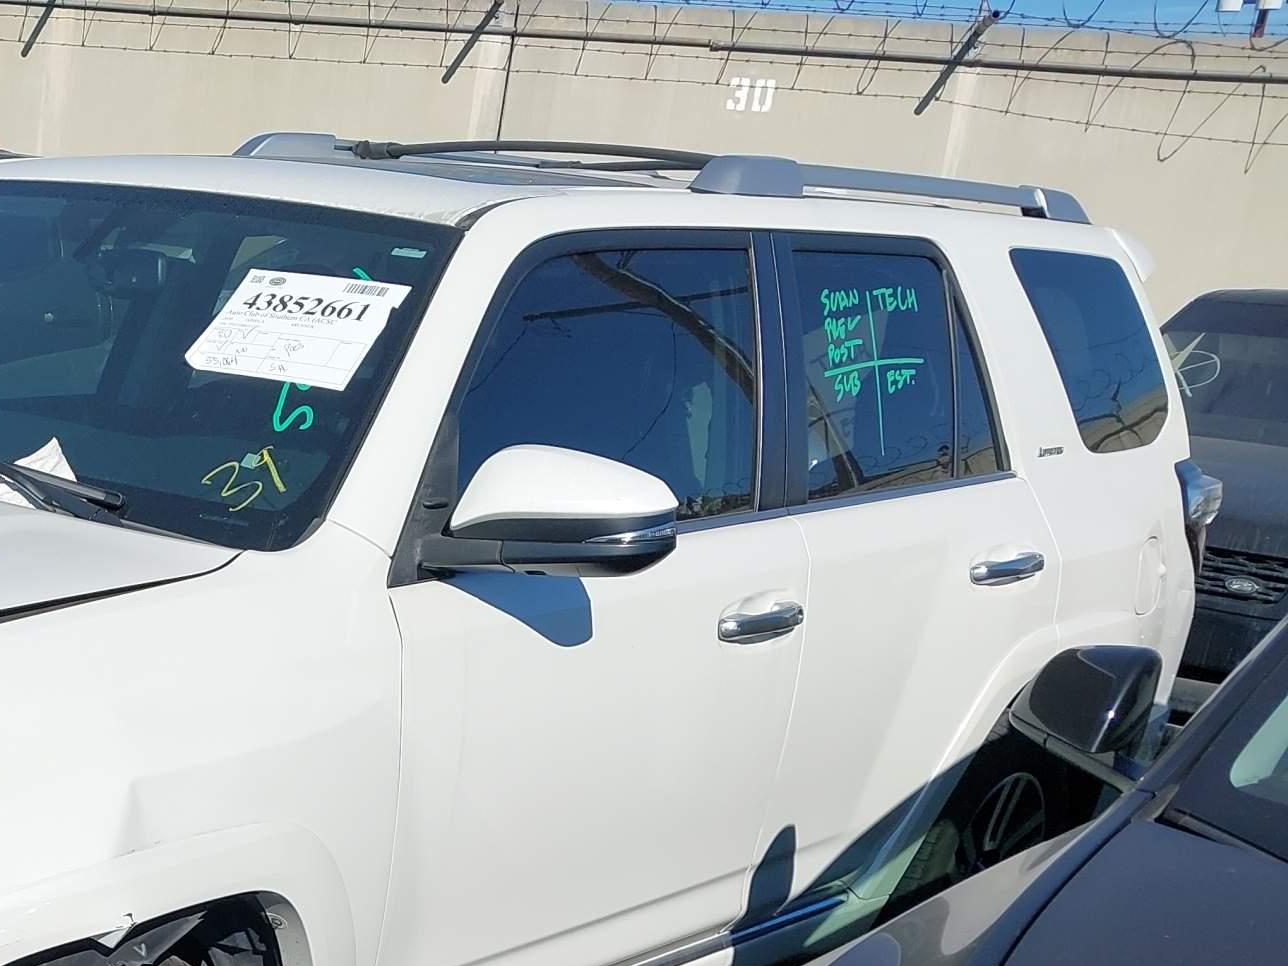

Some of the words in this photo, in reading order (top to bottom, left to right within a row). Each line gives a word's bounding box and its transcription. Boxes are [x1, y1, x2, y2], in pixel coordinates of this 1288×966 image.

[726, 77, 776, 112] 30
[242, 291, 371, 322] 43852661
[243, 310, 260, 318] Club
[269, 312, 299, 323] Southern
[827, 339, 863, 368] POST
[834, 371, 861, 402] SUB
